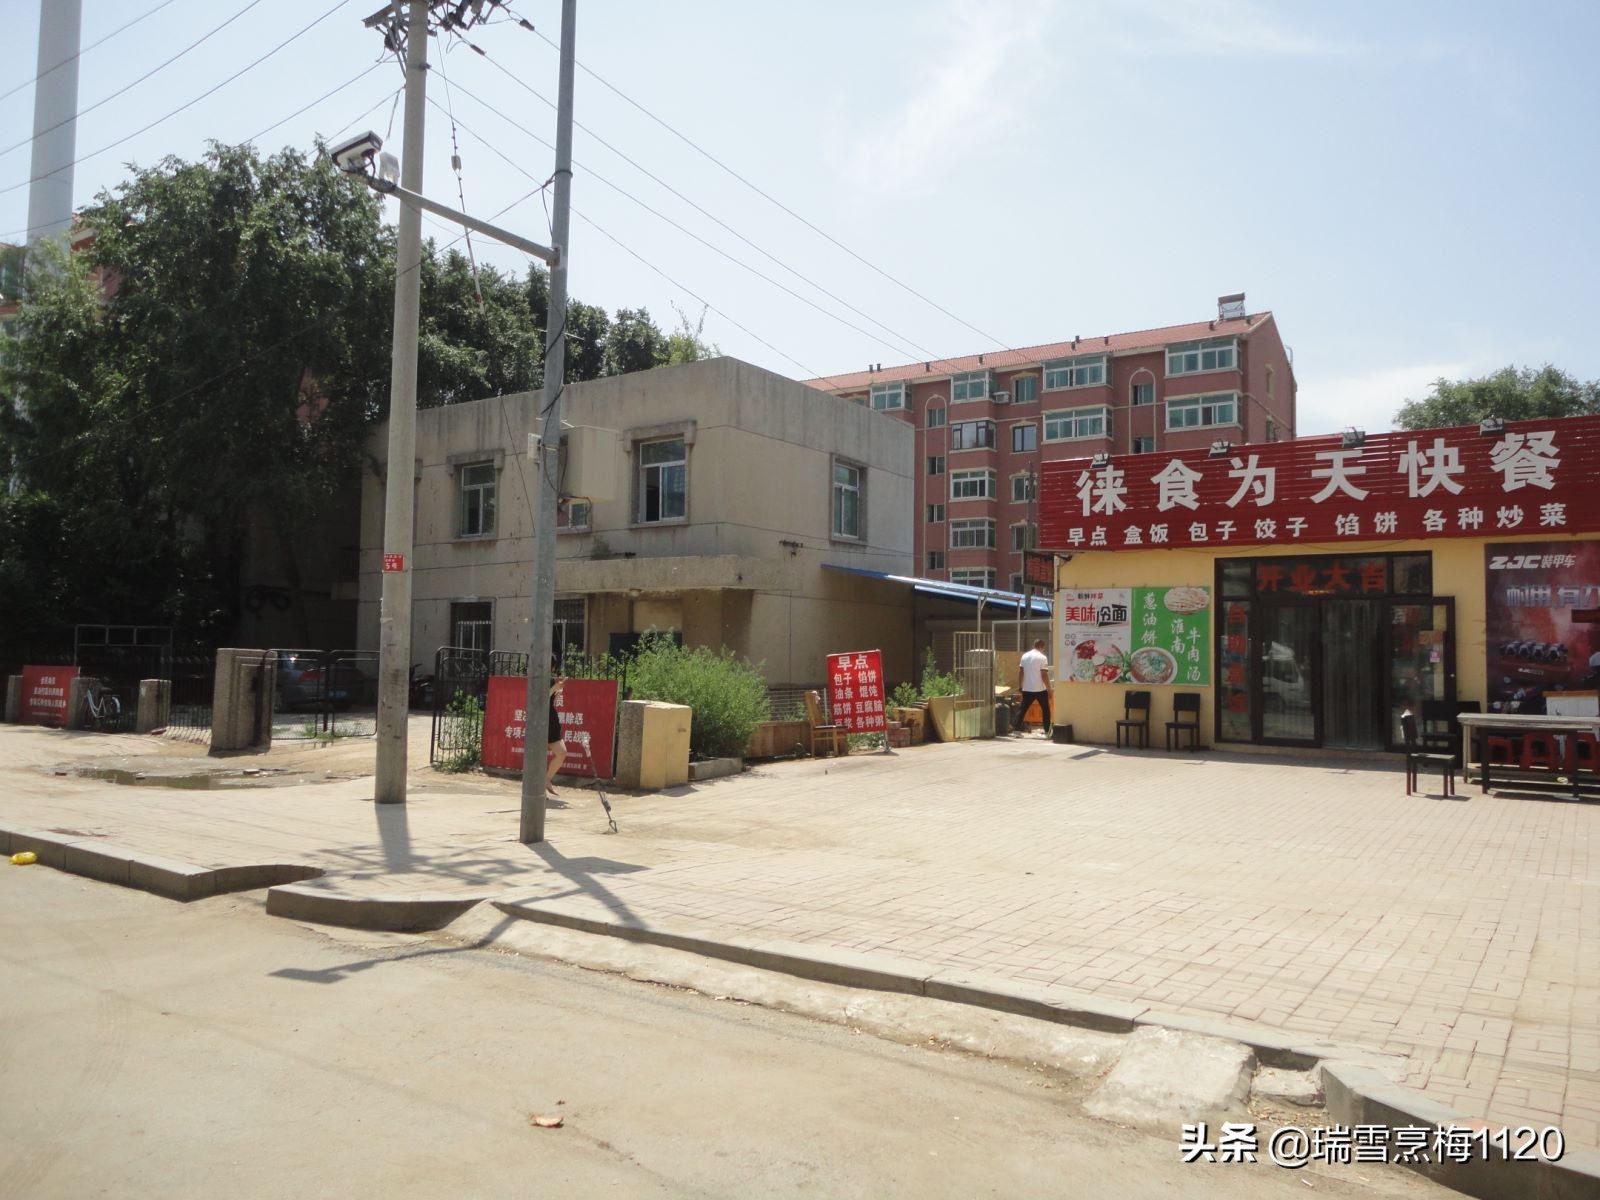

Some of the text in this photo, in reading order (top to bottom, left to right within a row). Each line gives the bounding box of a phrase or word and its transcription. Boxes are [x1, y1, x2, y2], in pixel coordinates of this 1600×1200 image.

[1075, 430, 1561, 517] 徕食为天快餐
[1067, 503, 1567, 547] 早点 盒饭 包子 饺子 馅饼 各种炒菜
[1489, 555, 1541, 570] ZJC
[1065, 603, 1127, 624] 美味冷面
[1141, 591, 1158, 646] 葱油饼
[837, 654, 869, 671] 早点
[1186, 627, 1201, 681] 牛肉汤
[834, 670, 877, 686] 包子 馅饼
[835, 687, 853, 700] 油条
